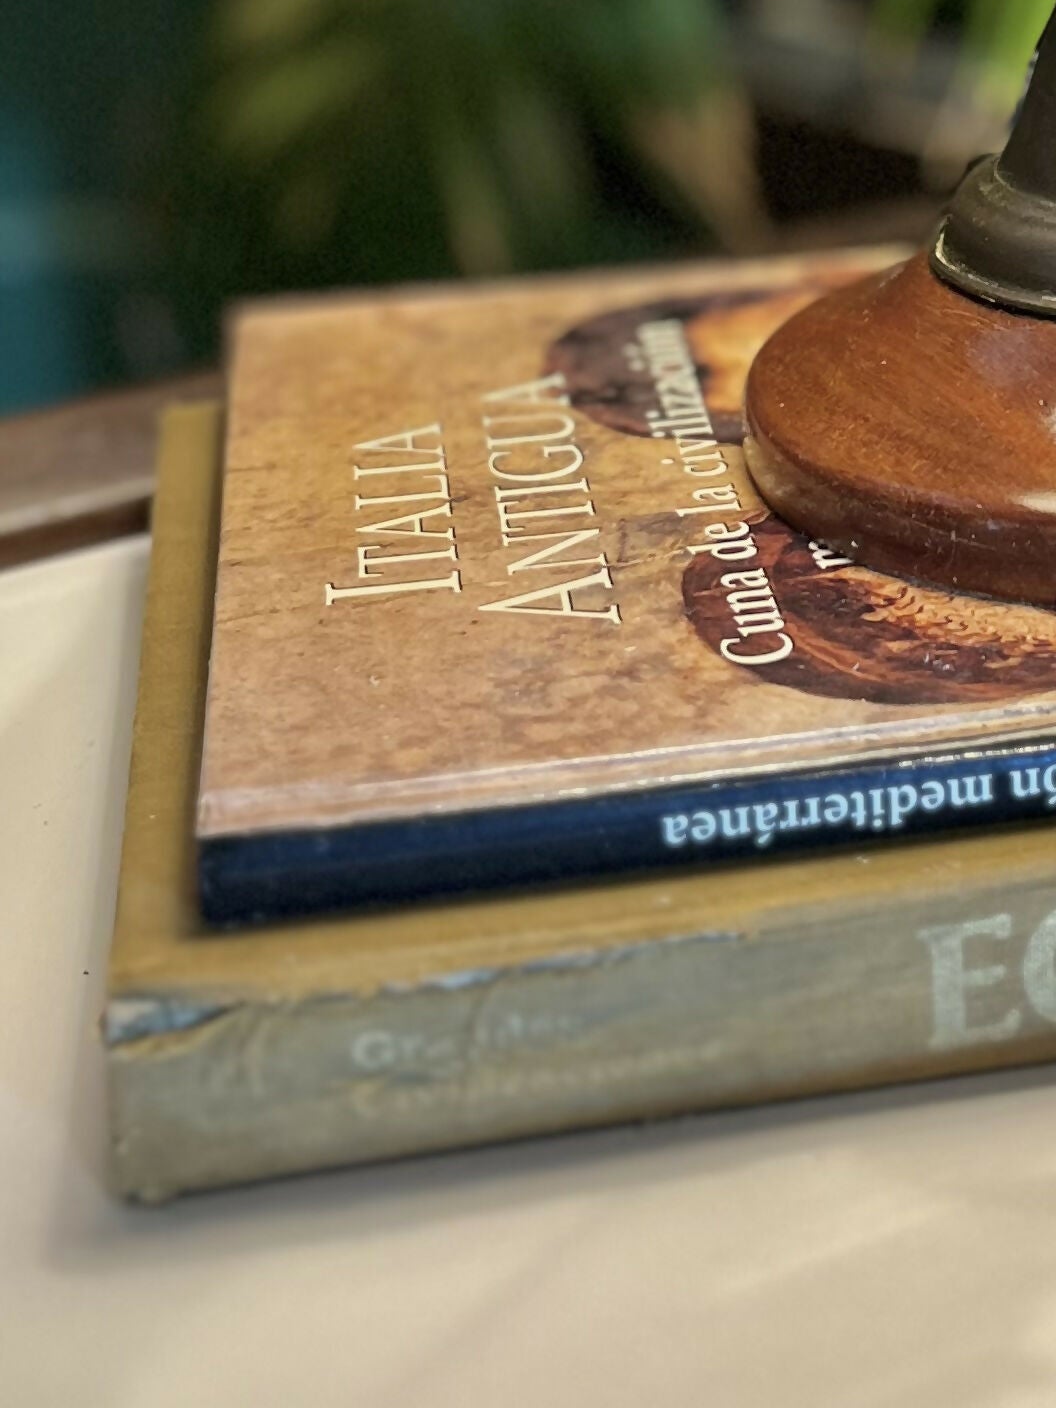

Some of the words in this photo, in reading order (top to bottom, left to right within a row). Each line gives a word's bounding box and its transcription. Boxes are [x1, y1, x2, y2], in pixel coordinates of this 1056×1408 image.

[325, 423, 463, 606] ITALIA
[478, 373, 622, 625] ANTIGUA
[675, 483, 742, 518] la
[686, 521, 758, 562] de
[719, 567, 794, 666] Cuna
[661, 773, 992, 849] mediterránea
